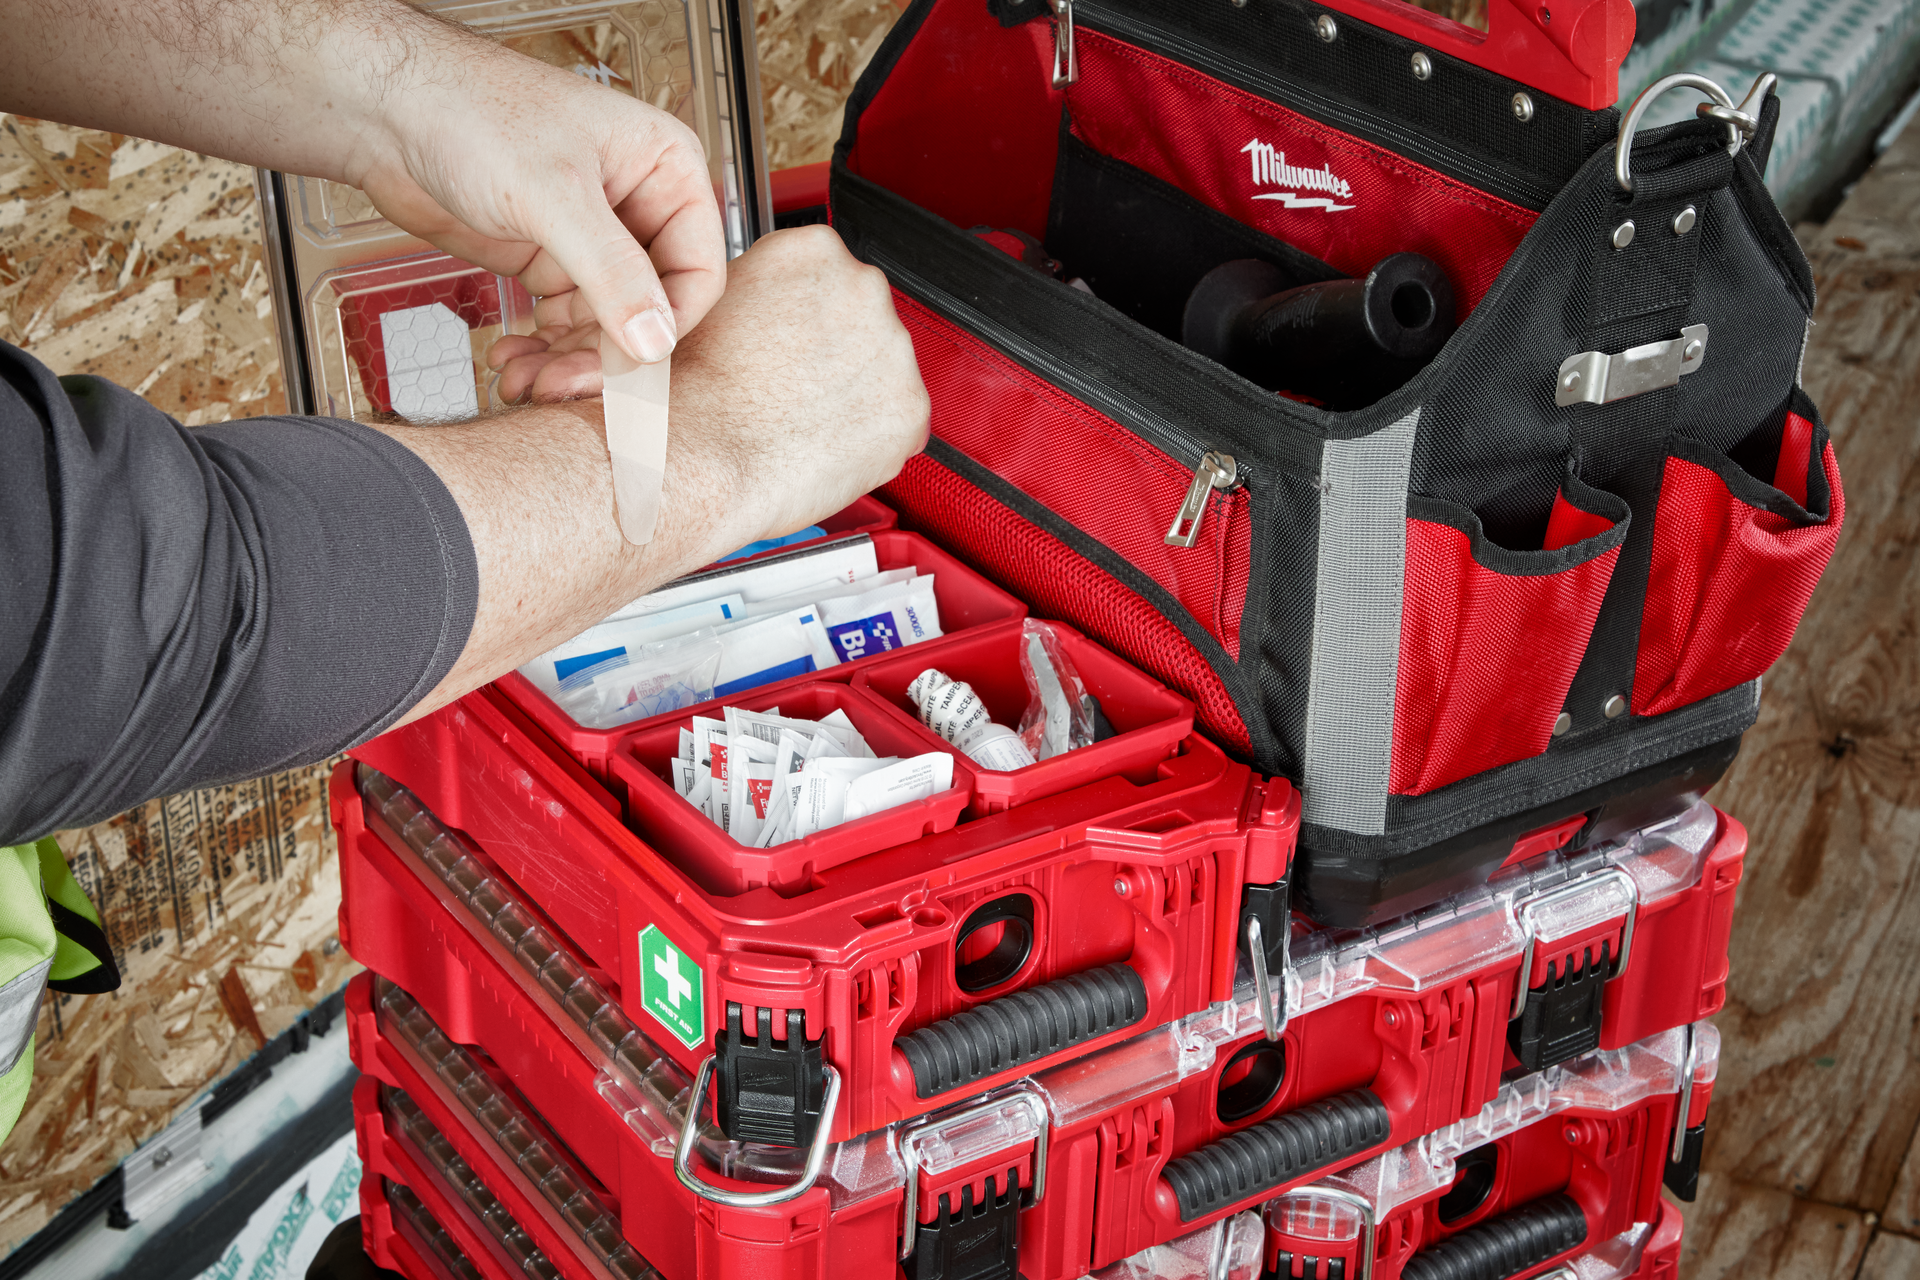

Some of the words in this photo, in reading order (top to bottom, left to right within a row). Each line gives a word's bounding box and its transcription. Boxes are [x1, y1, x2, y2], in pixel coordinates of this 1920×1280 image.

[1241, 138, 1353, 198] Milwaukee
[905, 606, 925, 637] 300005
[881, 635, 892, 651] FIR
[928, 671, 937, 690] TAMPE
[940, 681, 963, 710] TAMPER
[276, 772, 298, 860] TEGORY
[150, 821, 162, 848] FOR
[655, 997, 679, 1021] FIRST
[679, 1019, 693, 1035] AID
